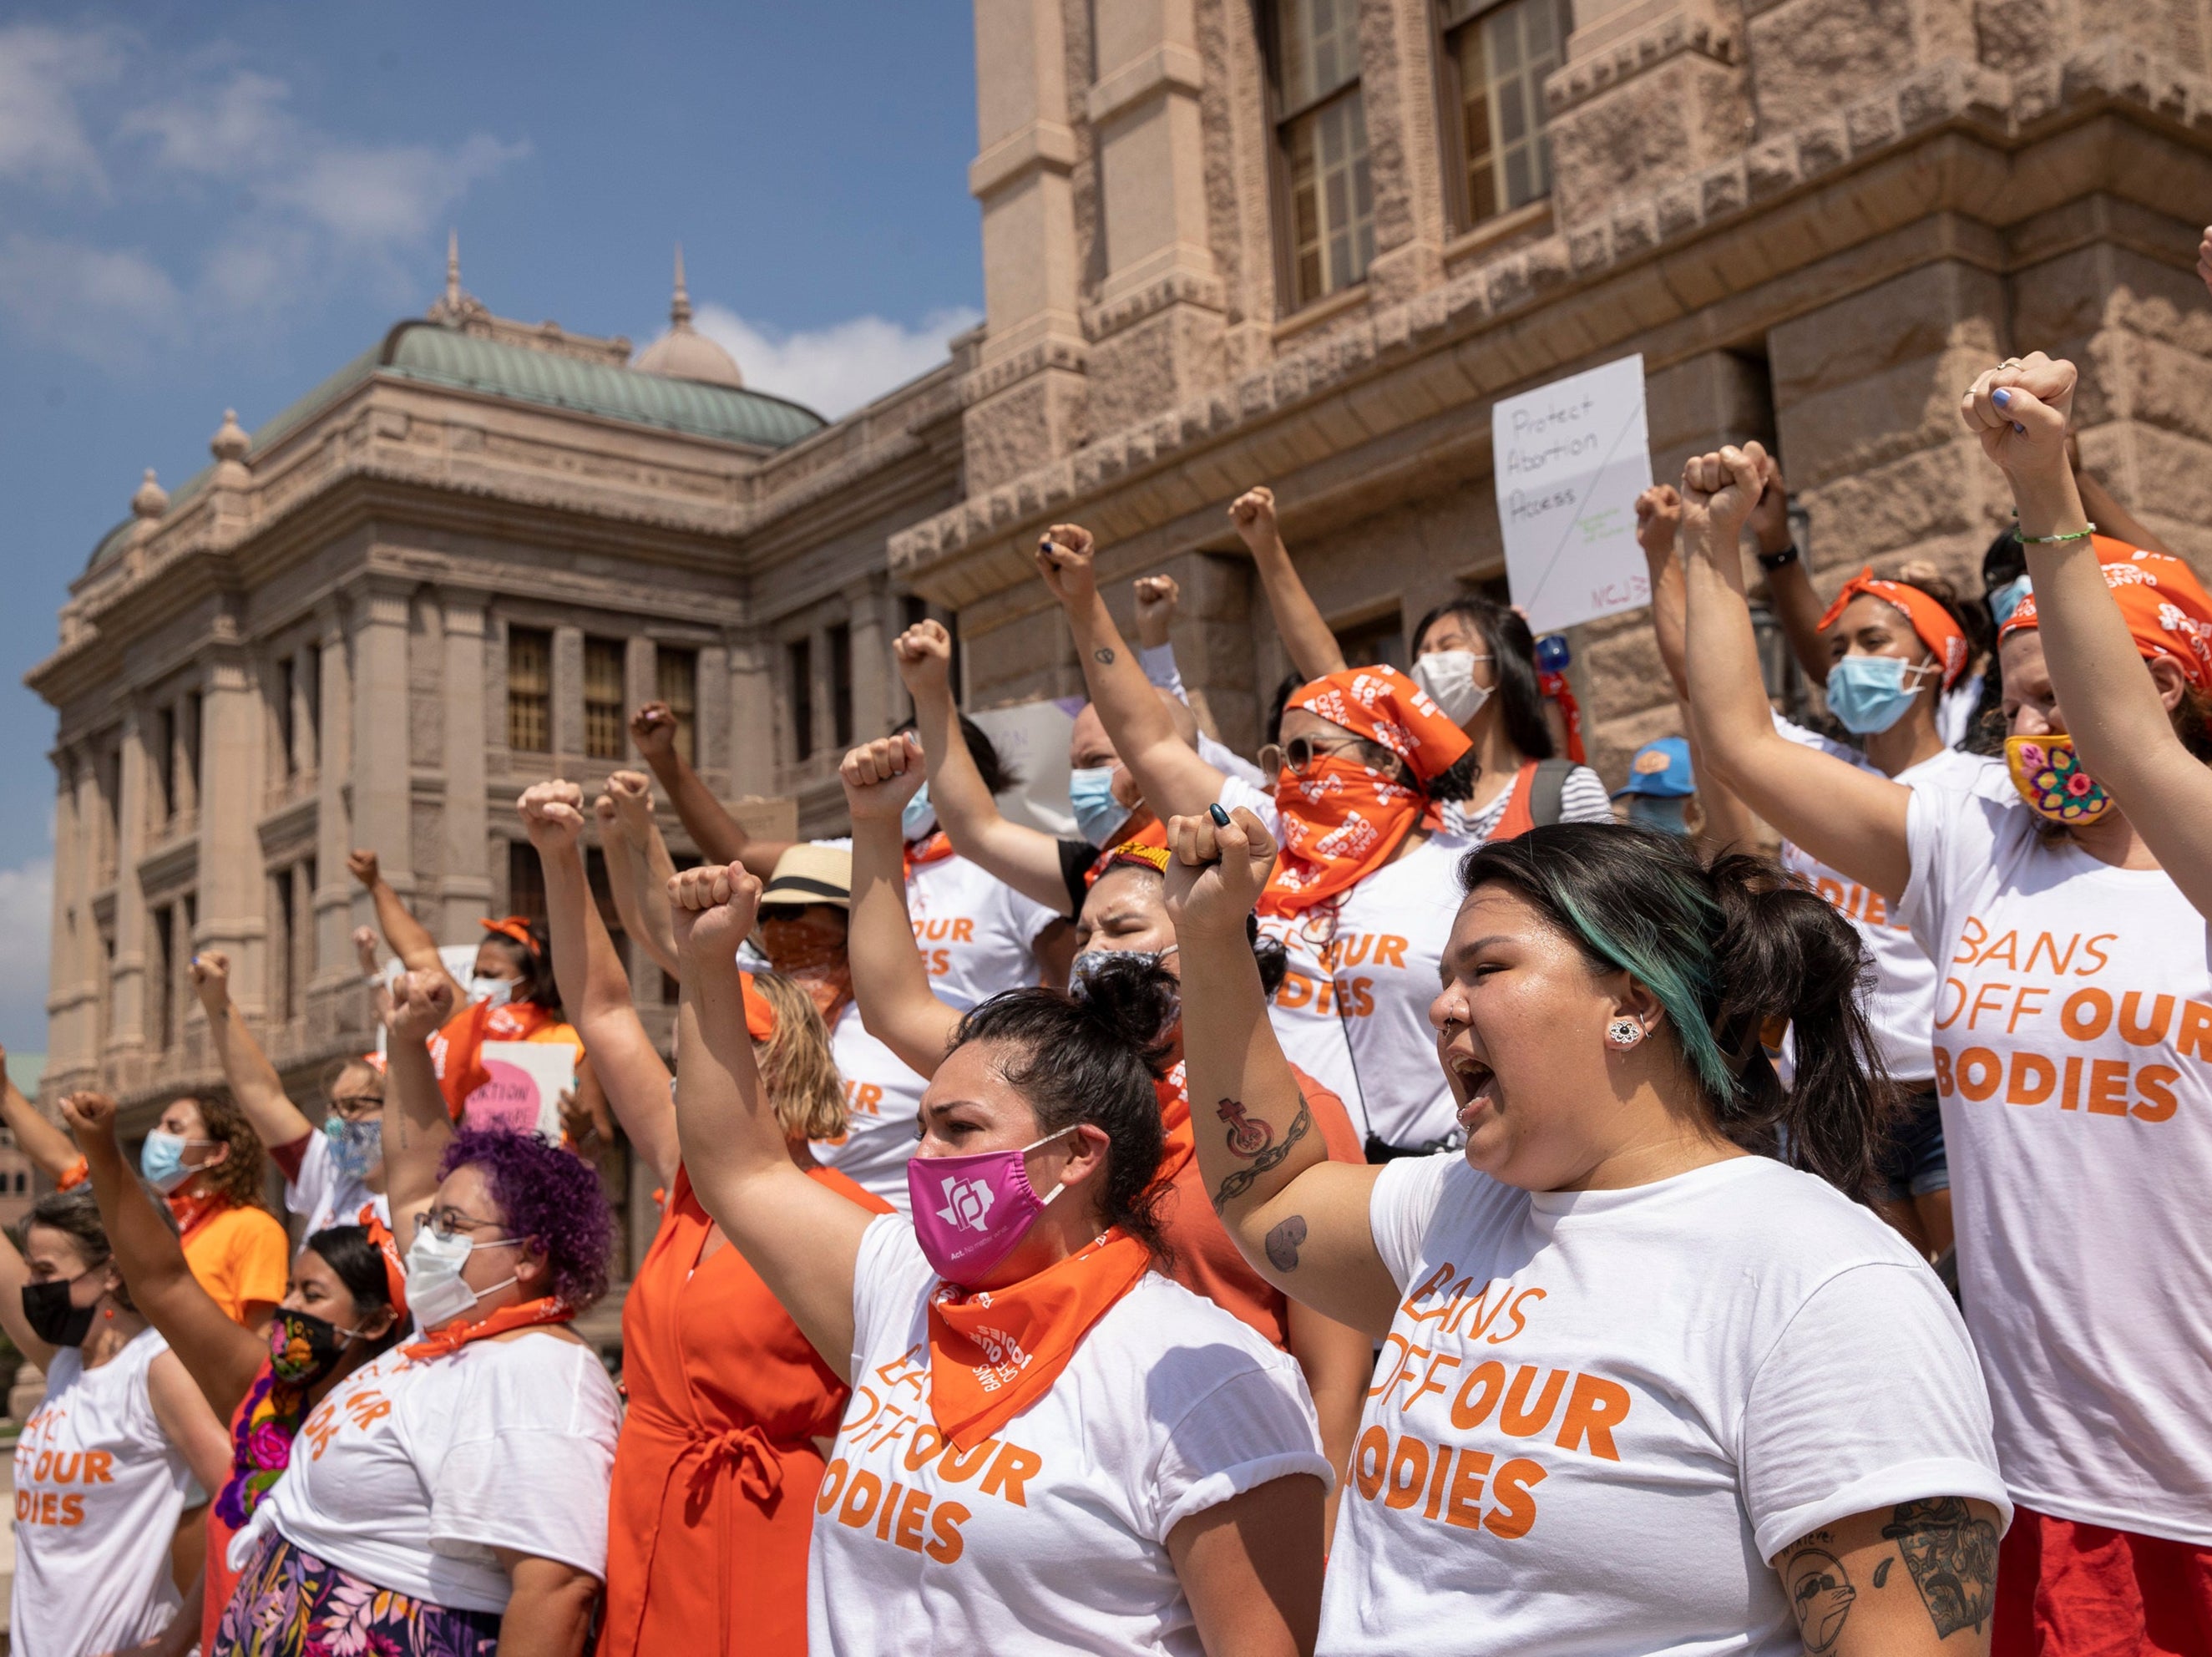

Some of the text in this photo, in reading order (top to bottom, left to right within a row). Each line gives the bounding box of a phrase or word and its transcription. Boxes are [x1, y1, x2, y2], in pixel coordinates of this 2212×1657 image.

[1952, 916, 2118, 976] BANS
[1935, 977, 2051, 1034] OFF
[1934, 1046, 2181, 1123] BODIES
[1400, 1261, 1547, 1345] BANS
[972, 1363, 1002, 1392] BANS
[995, 1360, 1018, 1383] OFF
[1369, 1332, 1631, 1462] OFF OUR
[33, 1450, 114, 1485] OUR
[904, 1424, 1042, 1508] OUR
[1345, 1424, 1548, 1540] ODIES
[16, 1489, 86, 1527] DIES
[816, 1457, 973, 1565] ODIES
